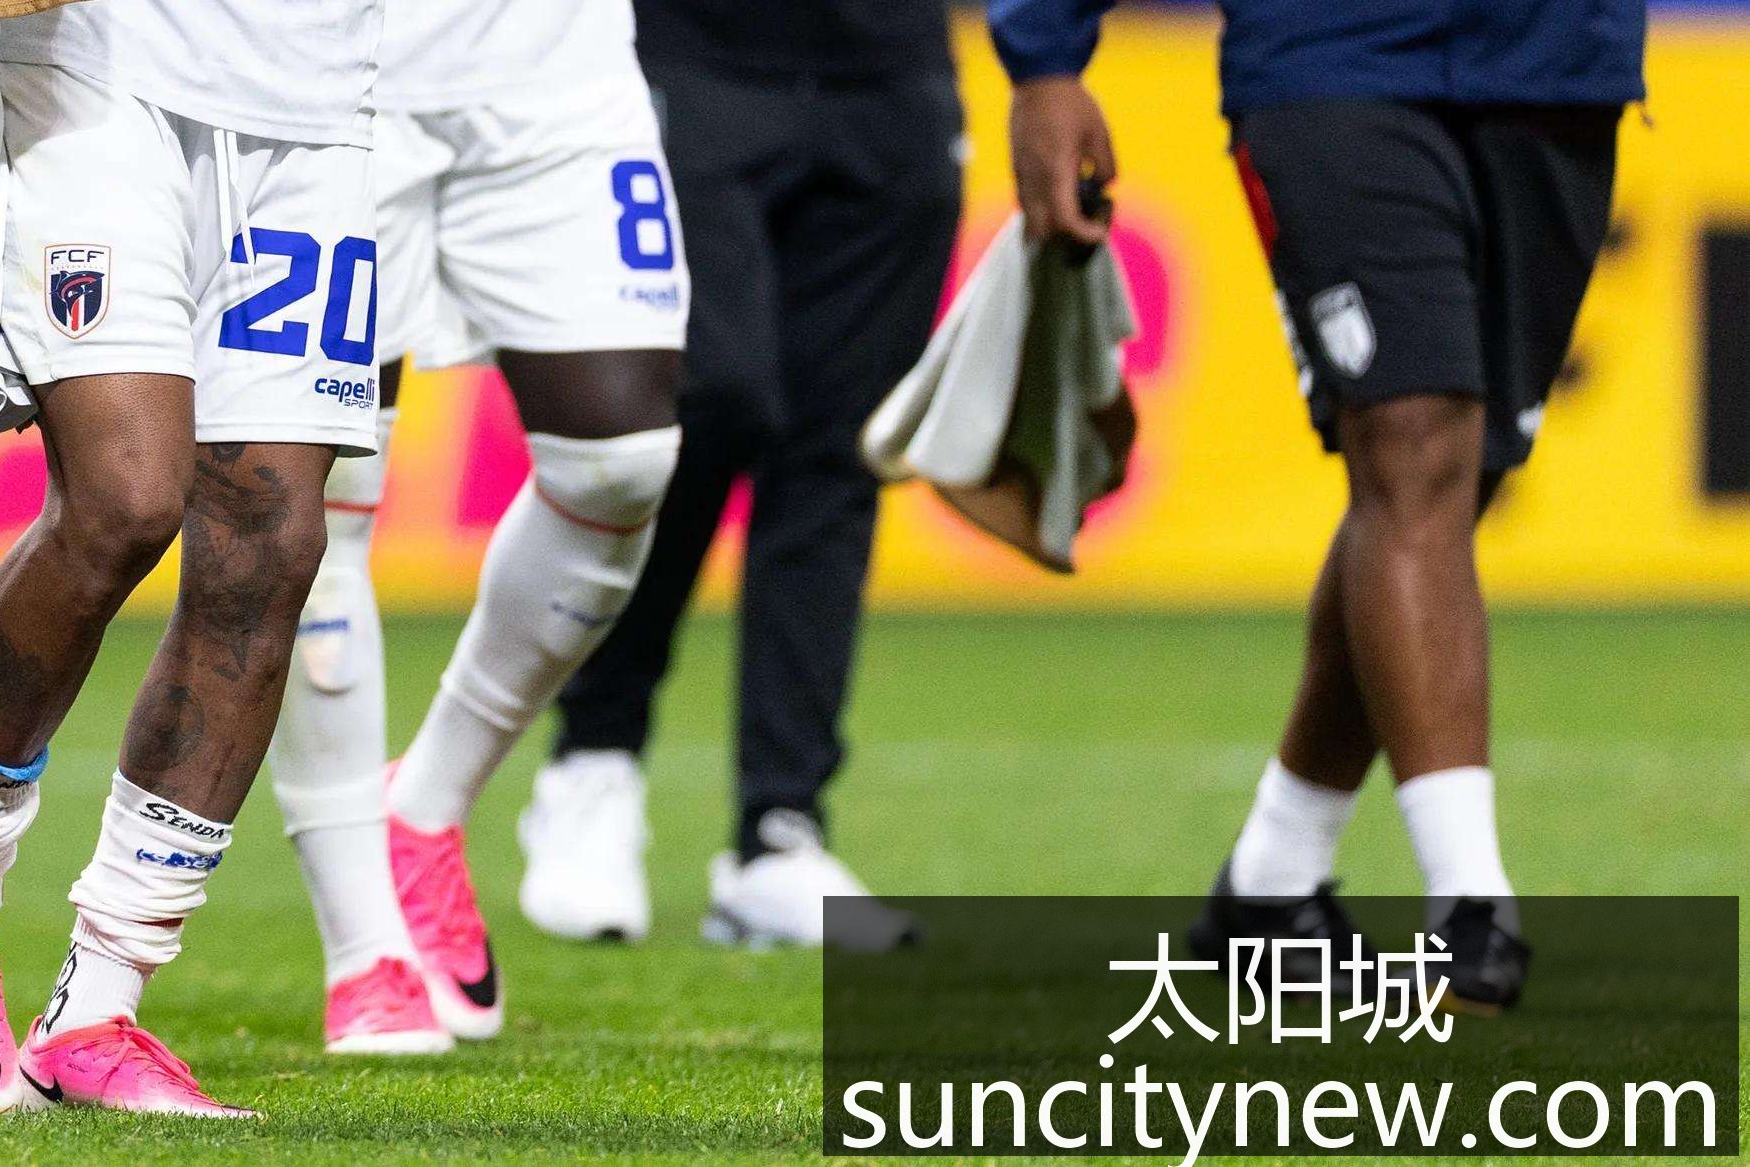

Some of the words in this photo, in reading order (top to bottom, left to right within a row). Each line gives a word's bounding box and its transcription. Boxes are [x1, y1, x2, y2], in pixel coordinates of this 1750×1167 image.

[611, 160, 674, 270] 8
[51, 249, 105, 265] FCF
[218, 228, 377, 366] 20
[314, 378, 375, 402] capelli
[344, 398, 374, 410] SPORT
[139, 802, 225, 839] SENDA
